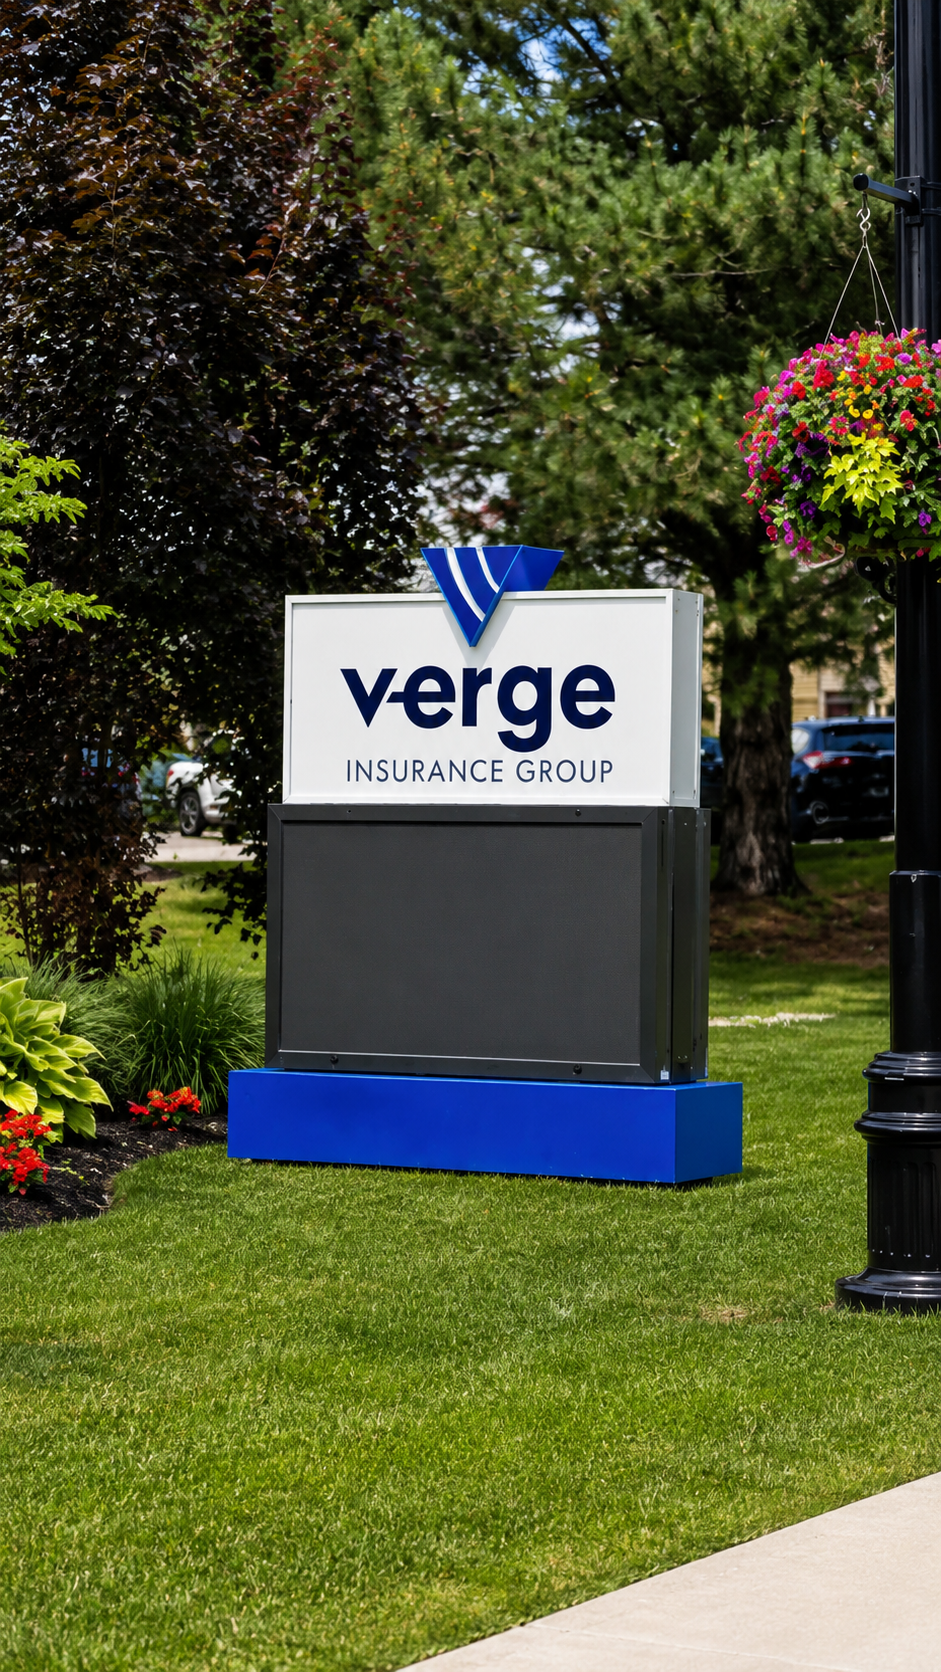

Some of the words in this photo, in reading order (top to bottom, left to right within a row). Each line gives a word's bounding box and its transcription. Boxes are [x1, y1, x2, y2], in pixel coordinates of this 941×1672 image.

[340, 665, 615, 752] verge
[347, 759, 503, 783] INSURANCE
[516, 760, 613, 783] GROUP
